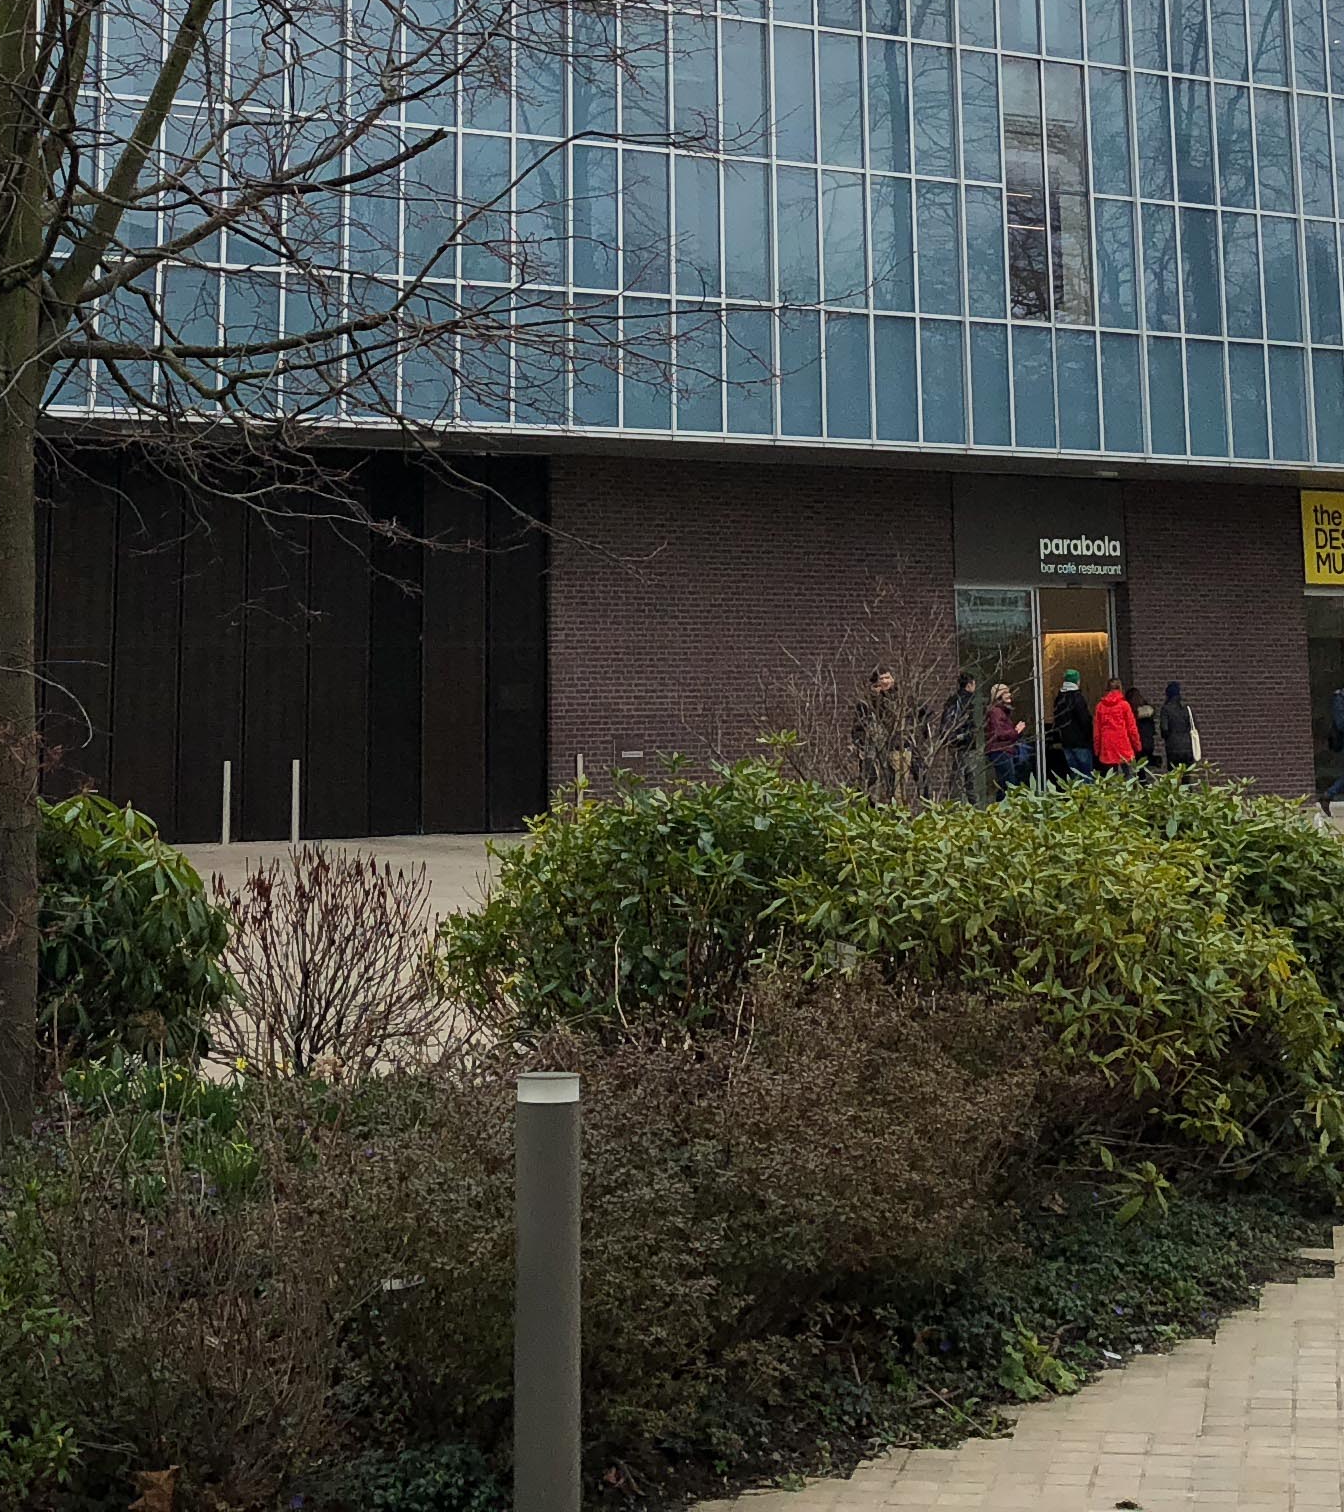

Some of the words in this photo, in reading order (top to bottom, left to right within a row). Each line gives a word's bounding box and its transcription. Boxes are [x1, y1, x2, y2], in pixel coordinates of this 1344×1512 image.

[1313, 504, 1342, 526] the
[1040, 535, 1121, 559] parabola
[1041, 561, 1056, 573] bar
[1078, 564, 1122, 575] restaurant
